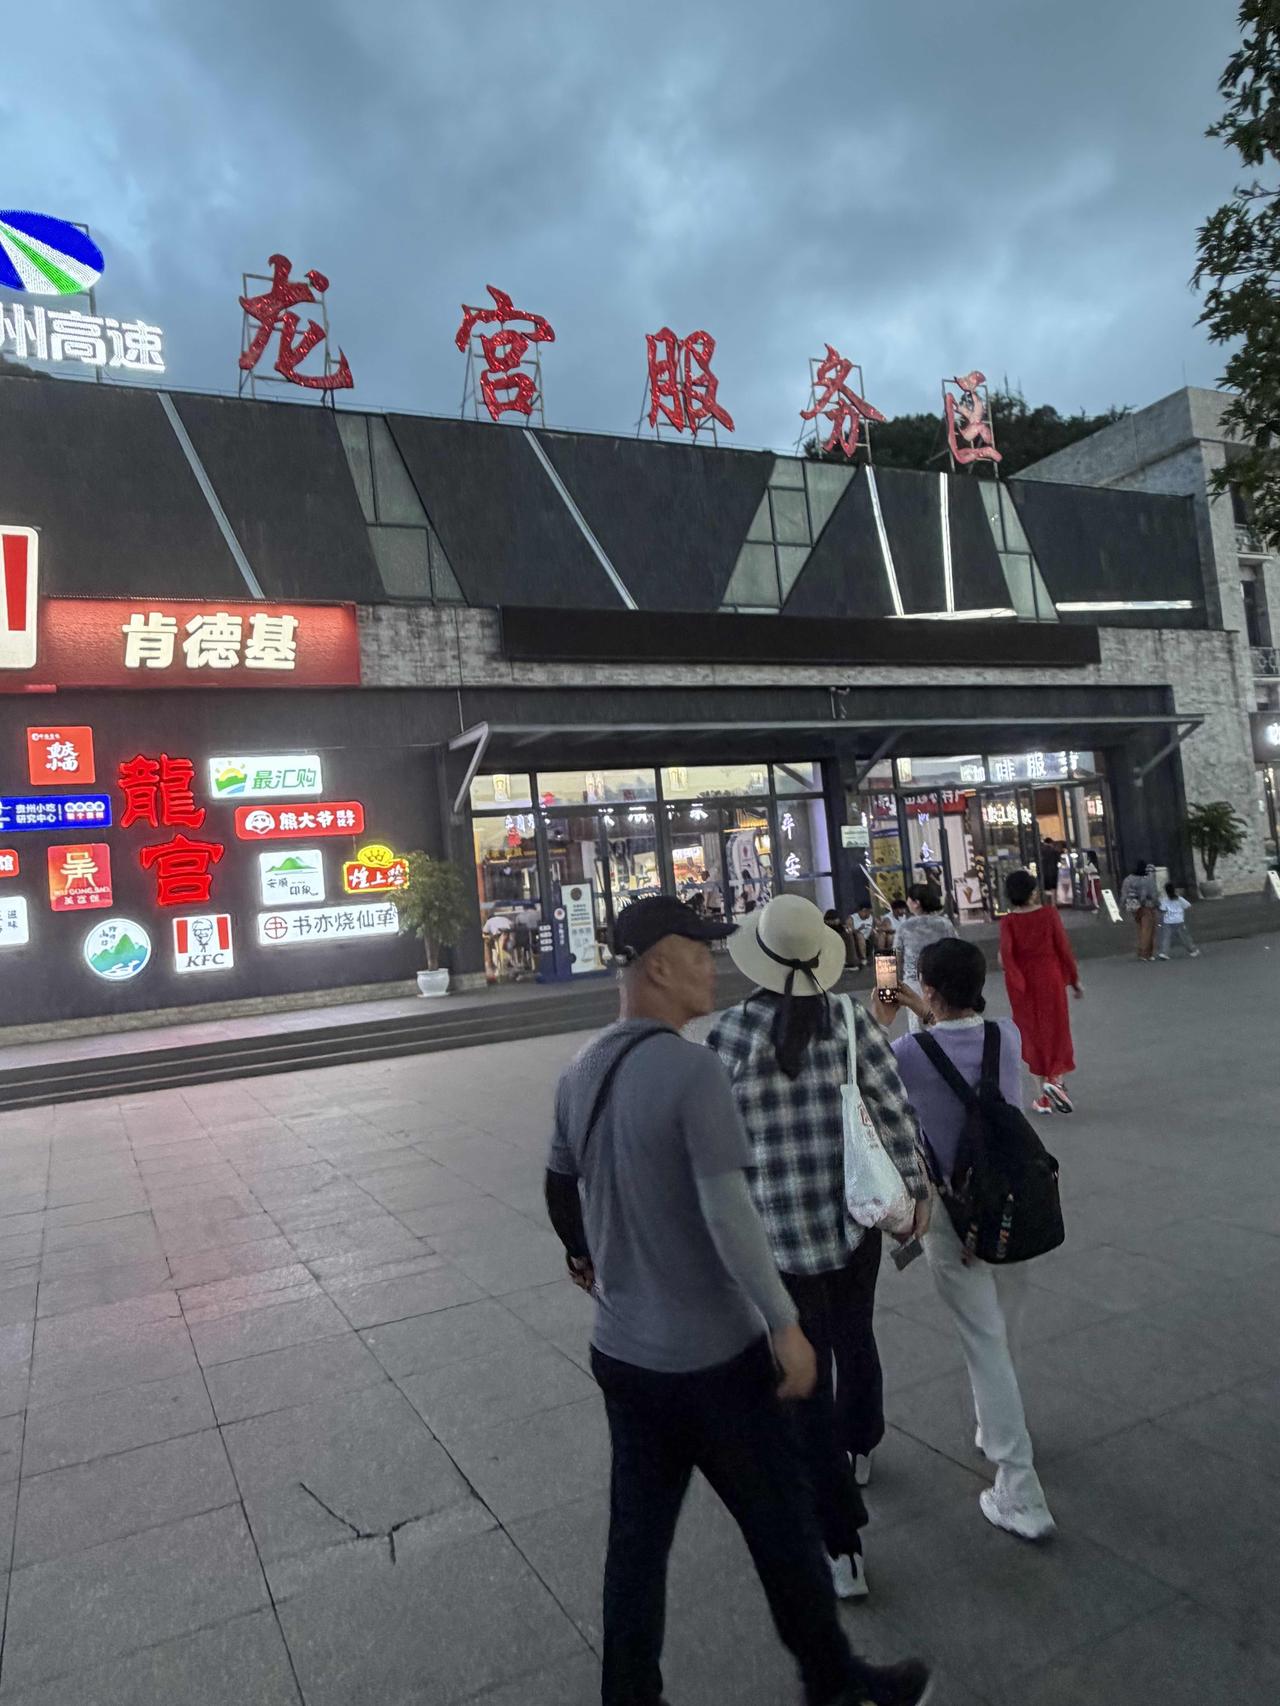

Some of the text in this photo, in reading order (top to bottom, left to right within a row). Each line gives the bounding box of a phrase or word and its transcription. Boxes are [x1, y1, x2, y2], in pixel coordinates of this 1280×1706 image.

[0, 303, 165, 373] 州高速
[121, 612, 299, 670] 肯德基
[252, 769, 316, 790] 最汇购
[15, 803, 57, 814] 贵州小吃
[16, 813, 57, 824] 研究中心
[279, 811, 334, 830] 熊大爷
[781, 813, 801, 877] 平安
[293, 910, 395, 936] 书亦烧仙草
[186, 953, 224, 968] KFC
